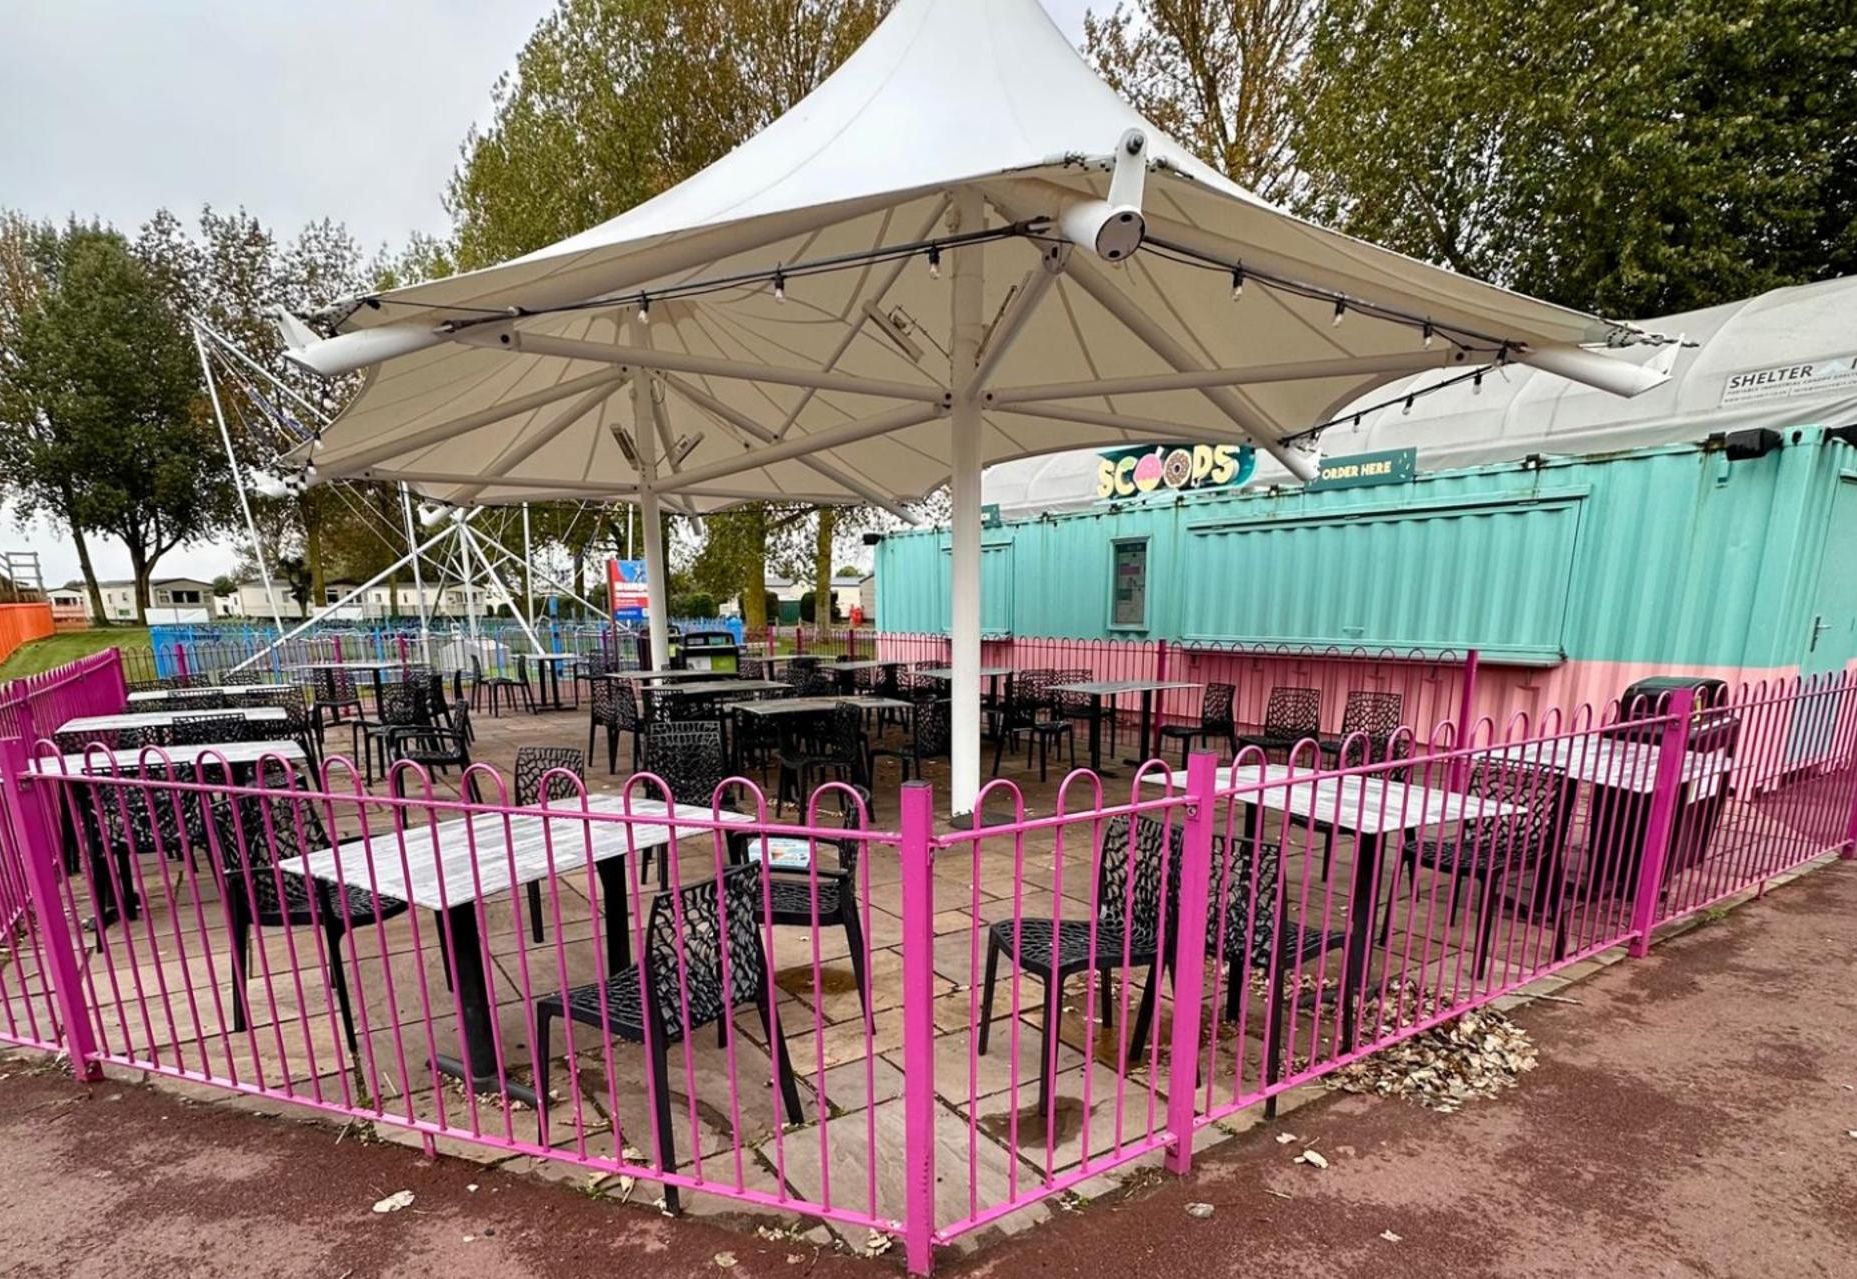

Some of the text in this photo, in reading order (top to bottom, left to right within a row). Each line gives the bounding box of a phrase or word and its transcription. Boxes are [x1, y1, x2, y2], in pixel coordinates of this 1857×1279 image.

[1729, 365, 1813, 389] SHELTER
[1096, 444, 1241, 498] SCOOPS
[1321, 461, 1391, 479] ORDER HERE
